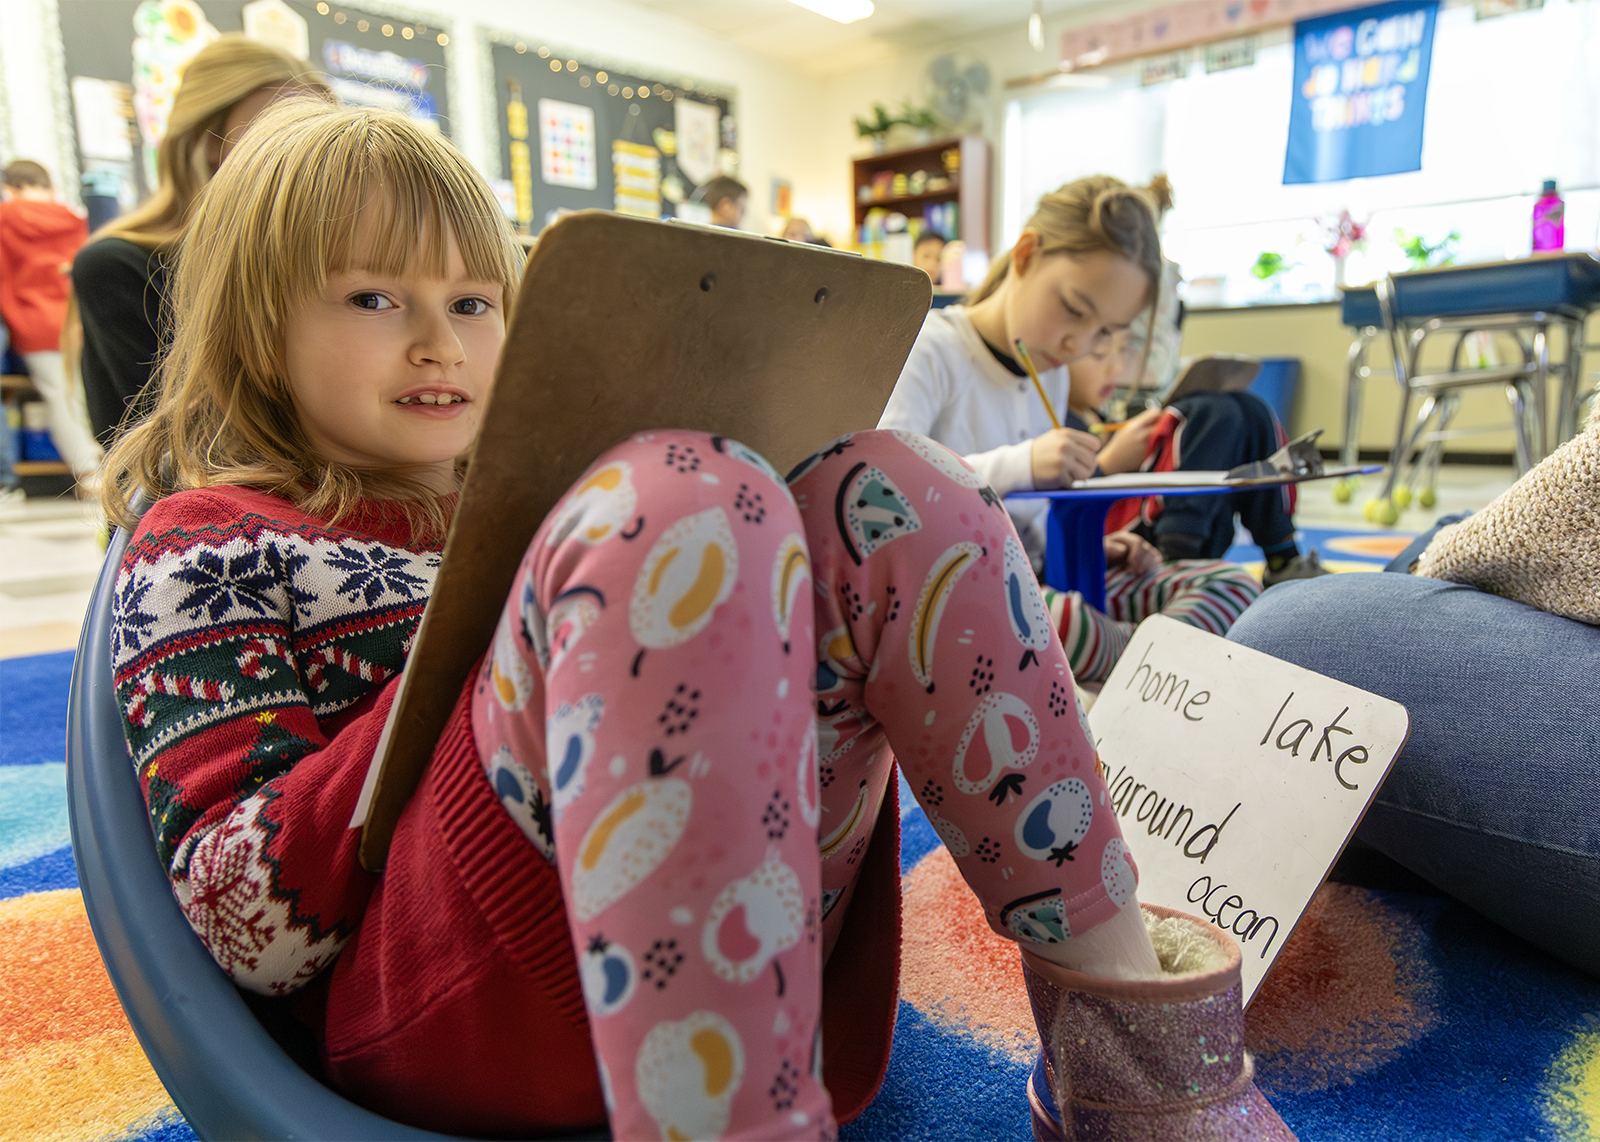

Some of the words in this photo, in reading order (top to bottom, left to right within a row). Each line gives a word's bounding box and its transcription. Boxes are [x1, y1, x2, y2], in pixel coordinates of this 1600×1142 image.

[1125, 641, 1211, 722] home
[1259, 691, 1369, 791] lake
[1186, 875, 1279, 960] ocean
